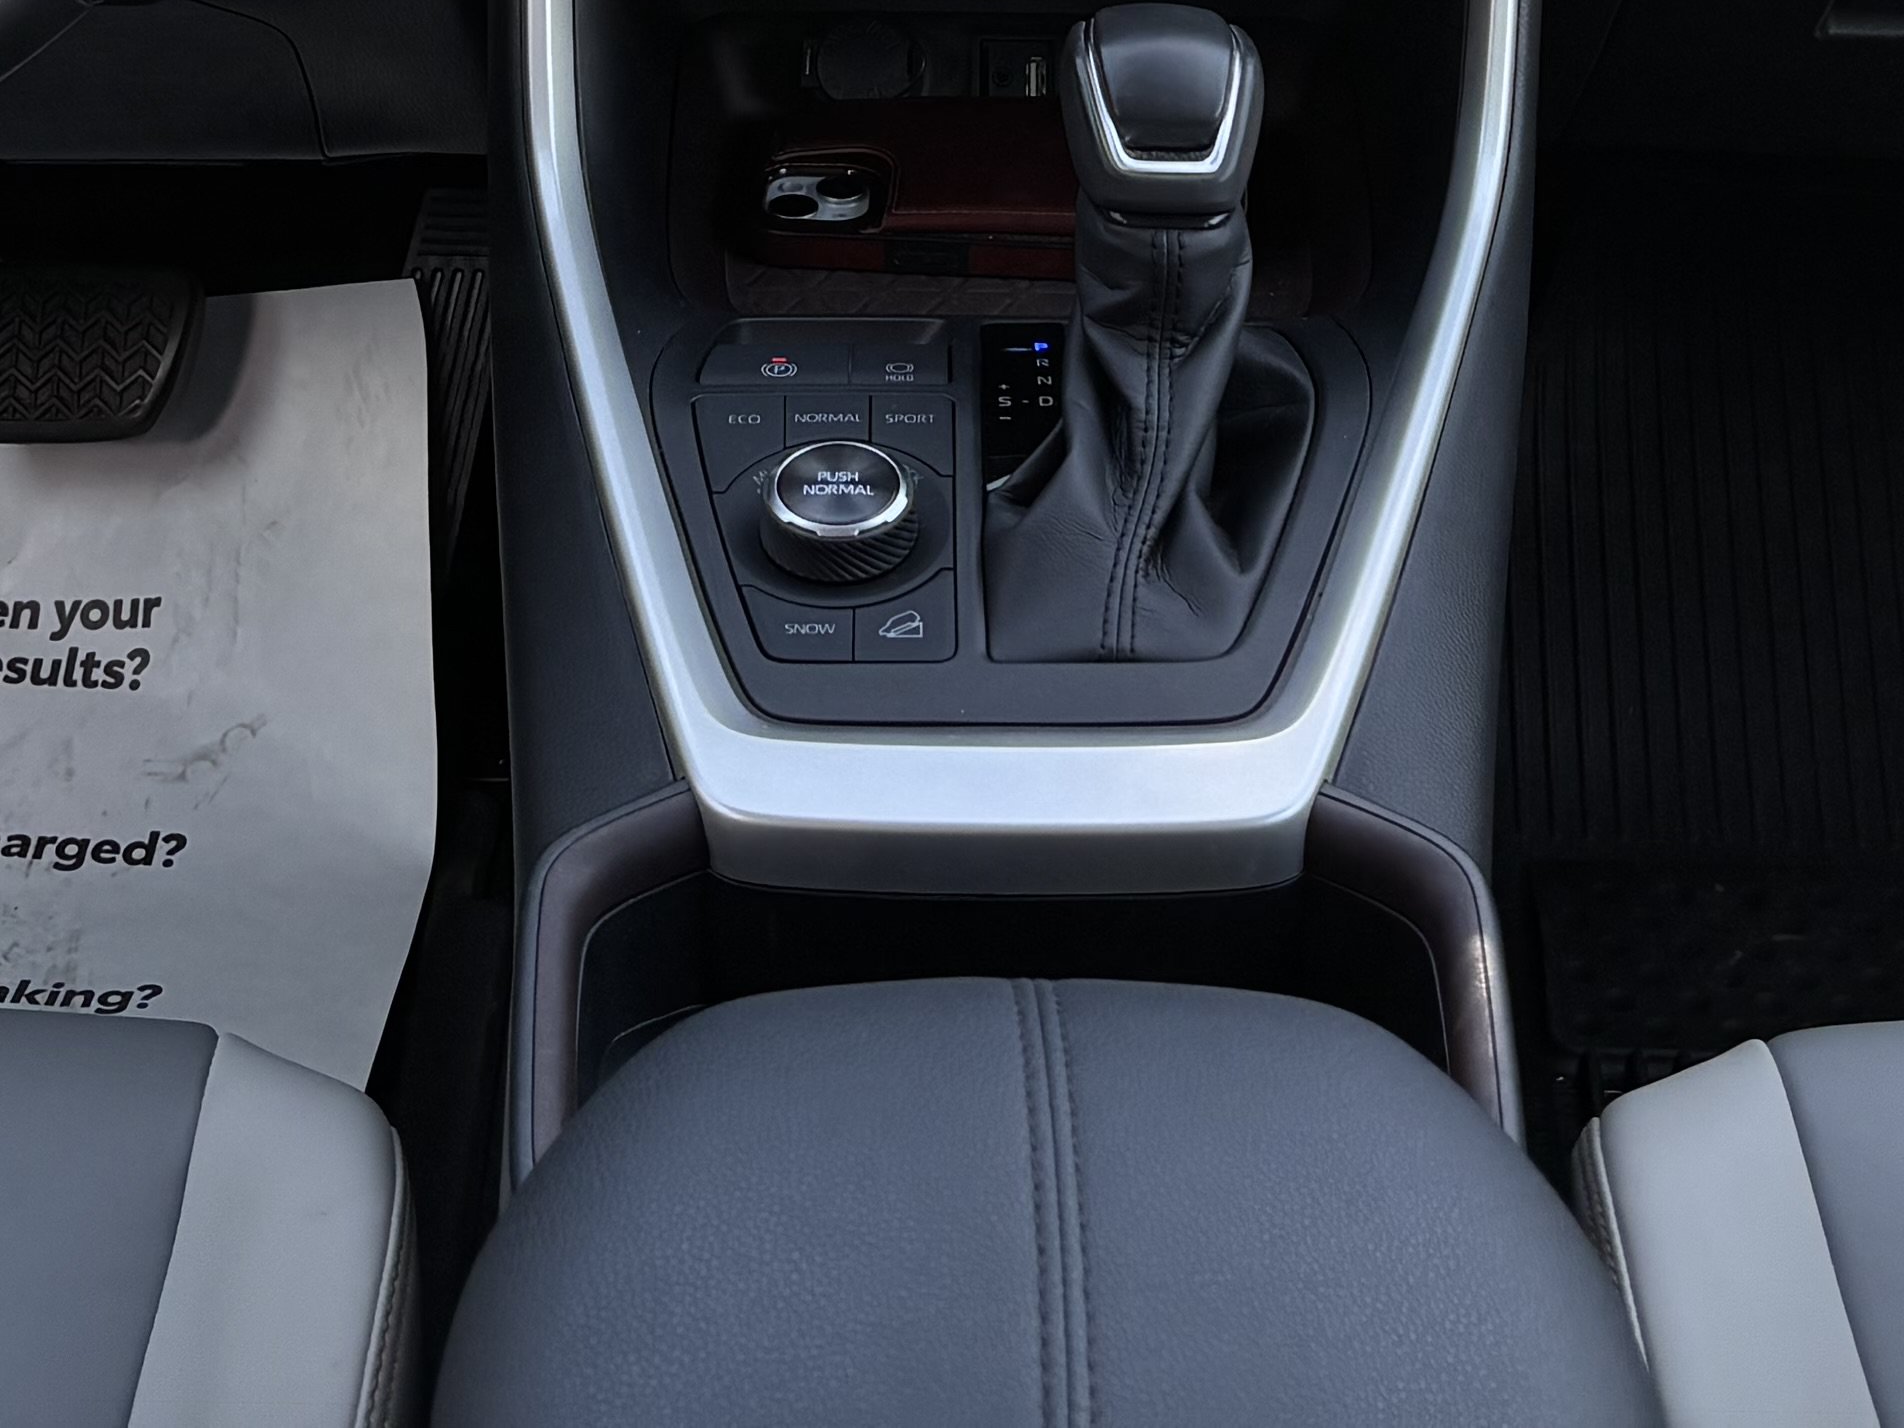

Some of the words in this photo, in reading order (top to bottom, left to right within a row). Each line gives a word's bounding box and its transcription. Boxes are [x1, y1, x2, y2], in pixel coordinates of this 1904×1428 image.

[998, 396, 1012, 407] S
[1038, 396, 1054, 407] D
[728, 413, 761, 425] ECO
[794, 413, 860, 423] NORMAL
[885, 414, 935, 424] SPORT
[817, 471, 859, 482] PUSH
[803, 484, 875, 495] NORMAL
[53, 591, 162, 641] your
[785, 622, 836, 635] SNOW
